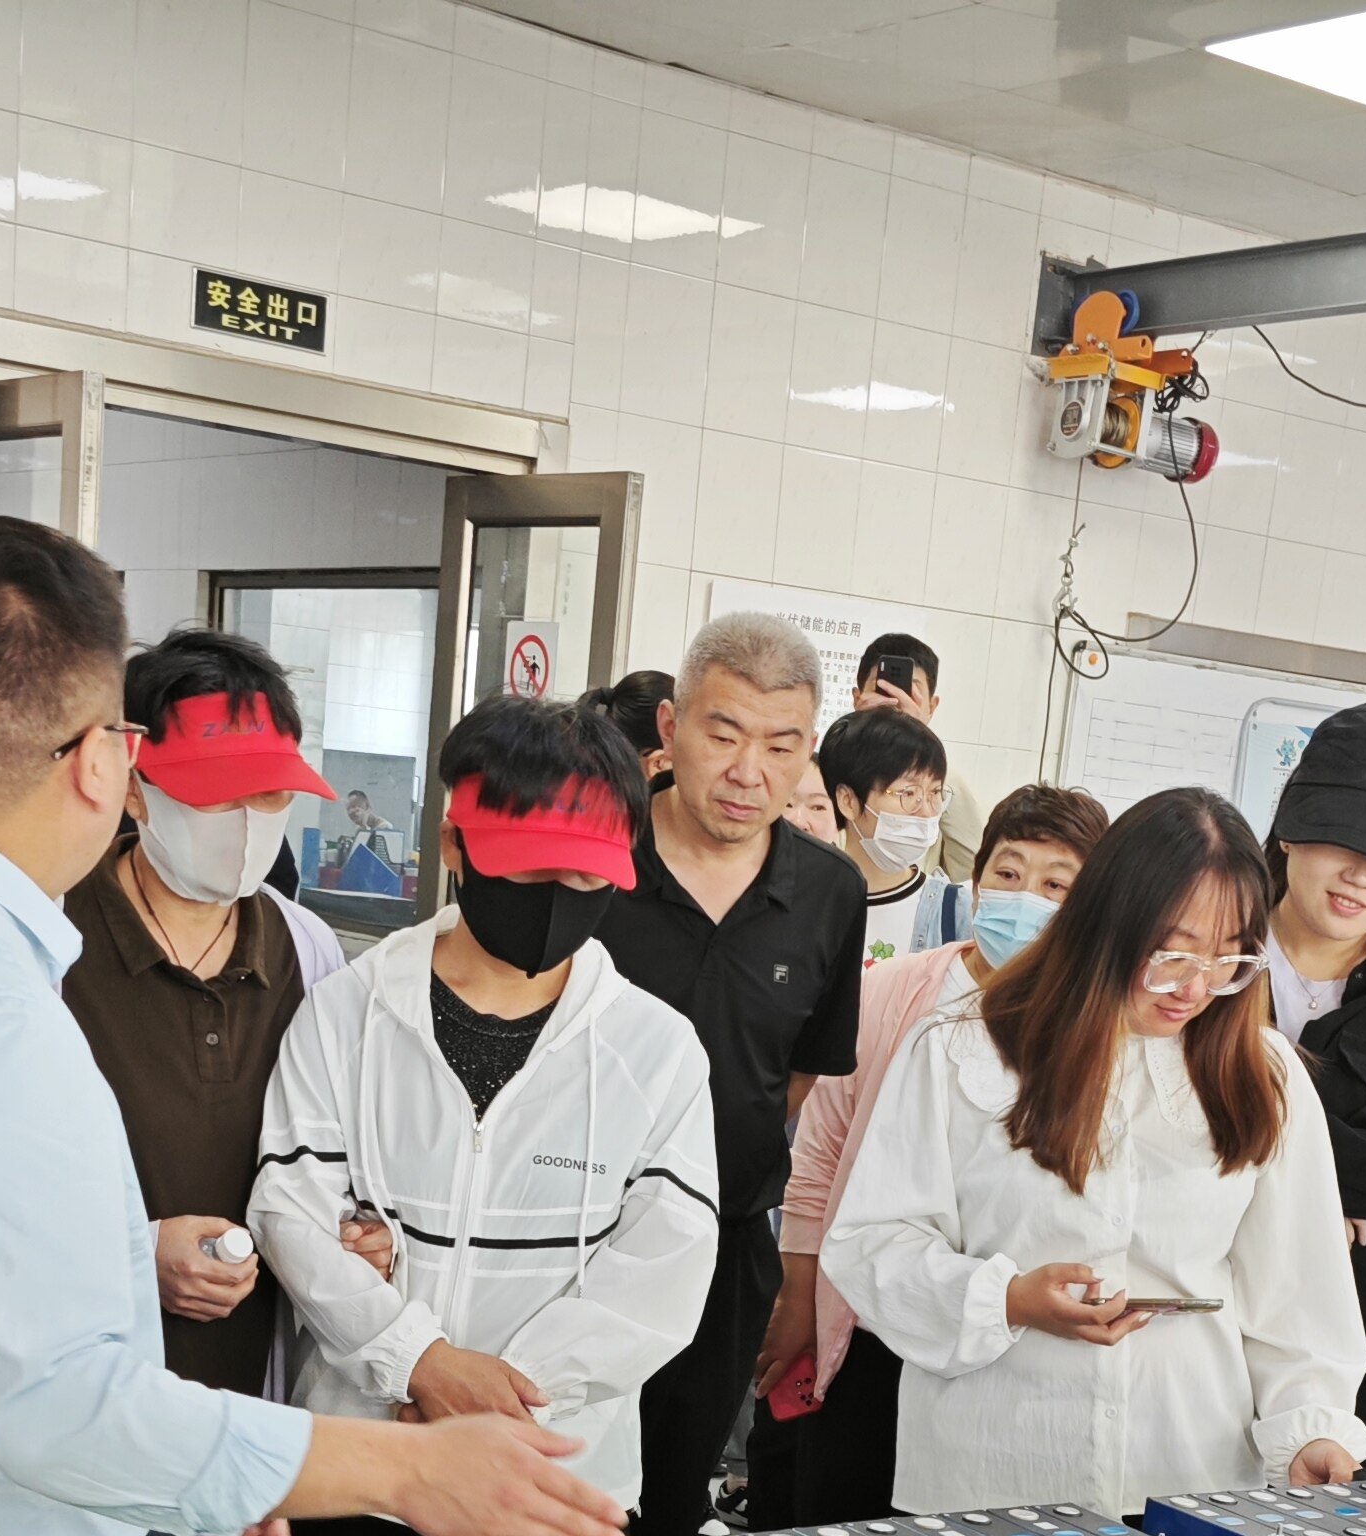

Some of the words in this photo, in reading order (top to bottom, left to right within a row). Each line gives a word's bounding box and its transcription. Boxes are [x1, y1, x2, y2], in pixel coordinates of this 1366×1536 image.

[207, 280, 317, 326] 安全出口
[221, 313, 300, 340] EXIT
